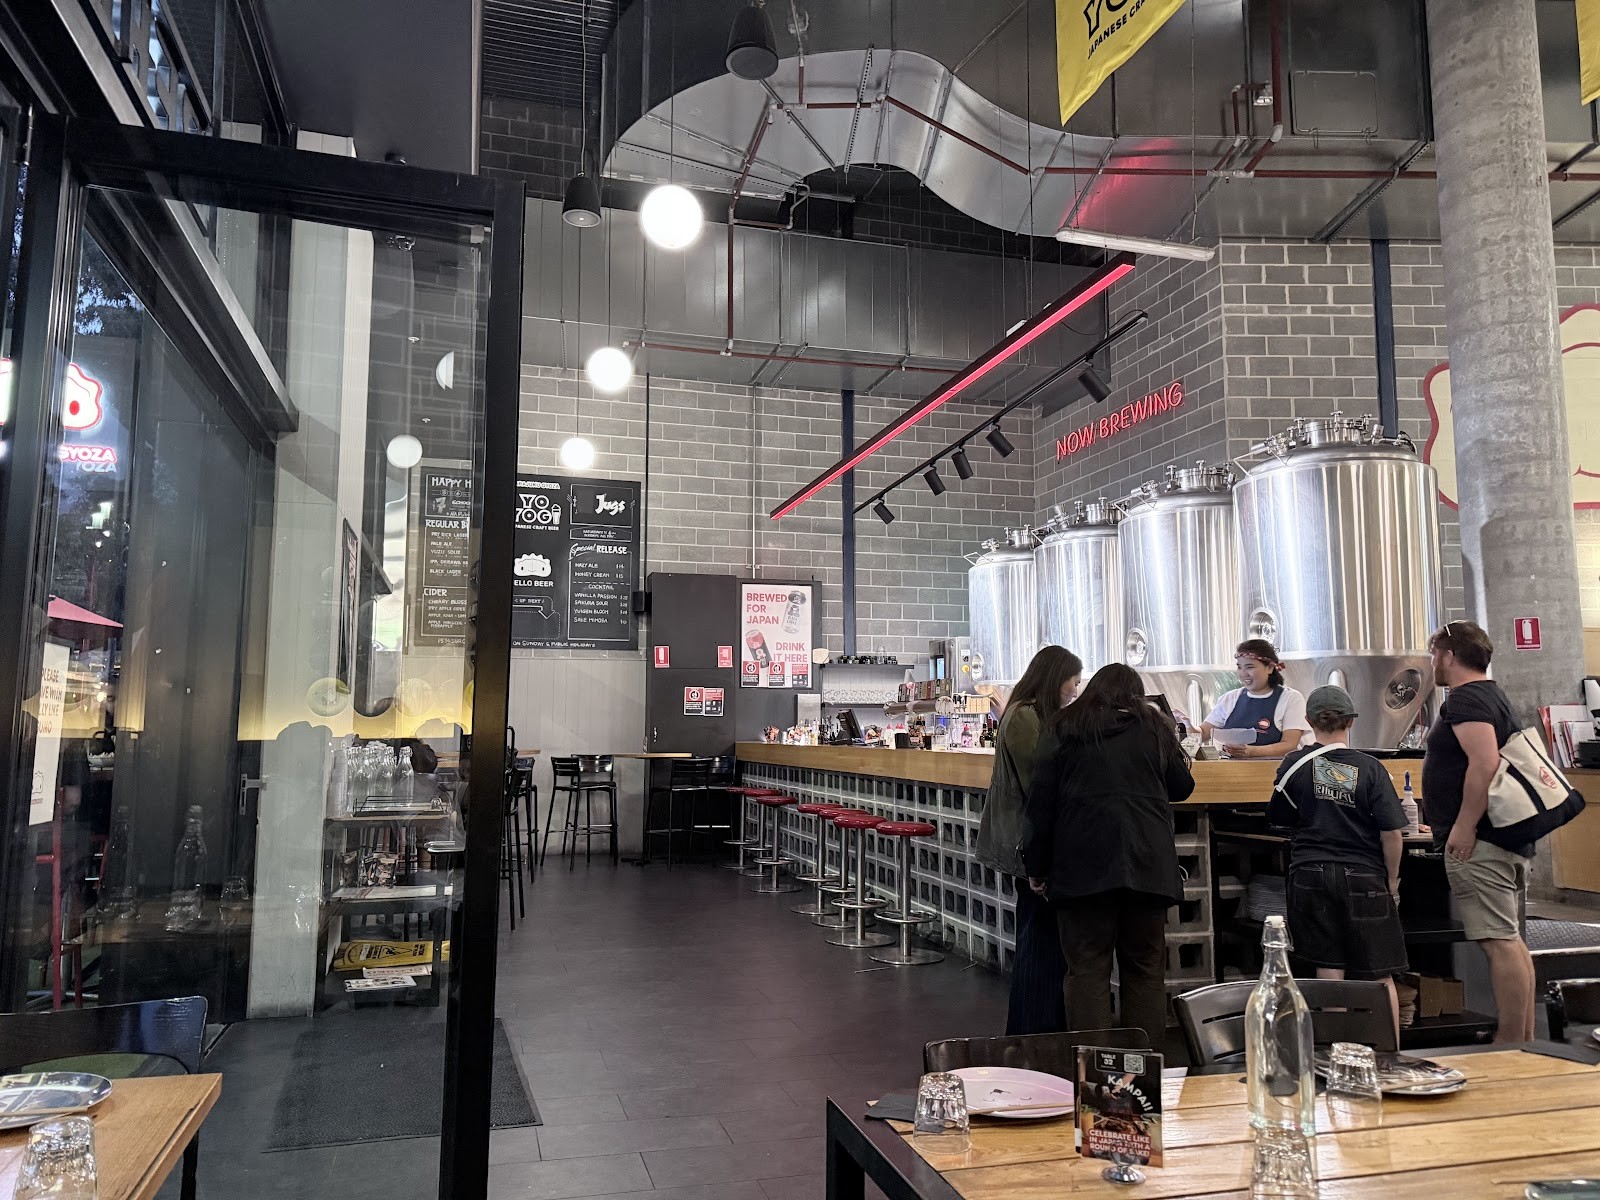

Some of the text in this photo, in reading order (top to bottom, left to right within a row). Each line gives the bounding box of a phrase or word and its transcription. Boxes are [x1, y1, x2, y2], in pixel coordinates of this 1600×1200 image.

[1087, 0, 1145, 59] JAPANESE CRA
[1056, 382, 1182, 460] NOW BREWING
[431, 477, 462, 488] HAPPY
[595, 493, 626, 516] Jugs
[425, 519, 460, 528] REGULAR
[596, 545, 628, 555] RELEASE
[423, 588, 447, 597] CIDER
[746, 593, 788, 603] BREWED
[746, 604, 767, 613] FOR
[746, 615, 779, 625] JAPAN
[775, 641, 805, 651] DRINK
[773, 653, 808, 663] IT HERE
[1089, 1129, 1150, 1143] CELEBRATE LIKE
